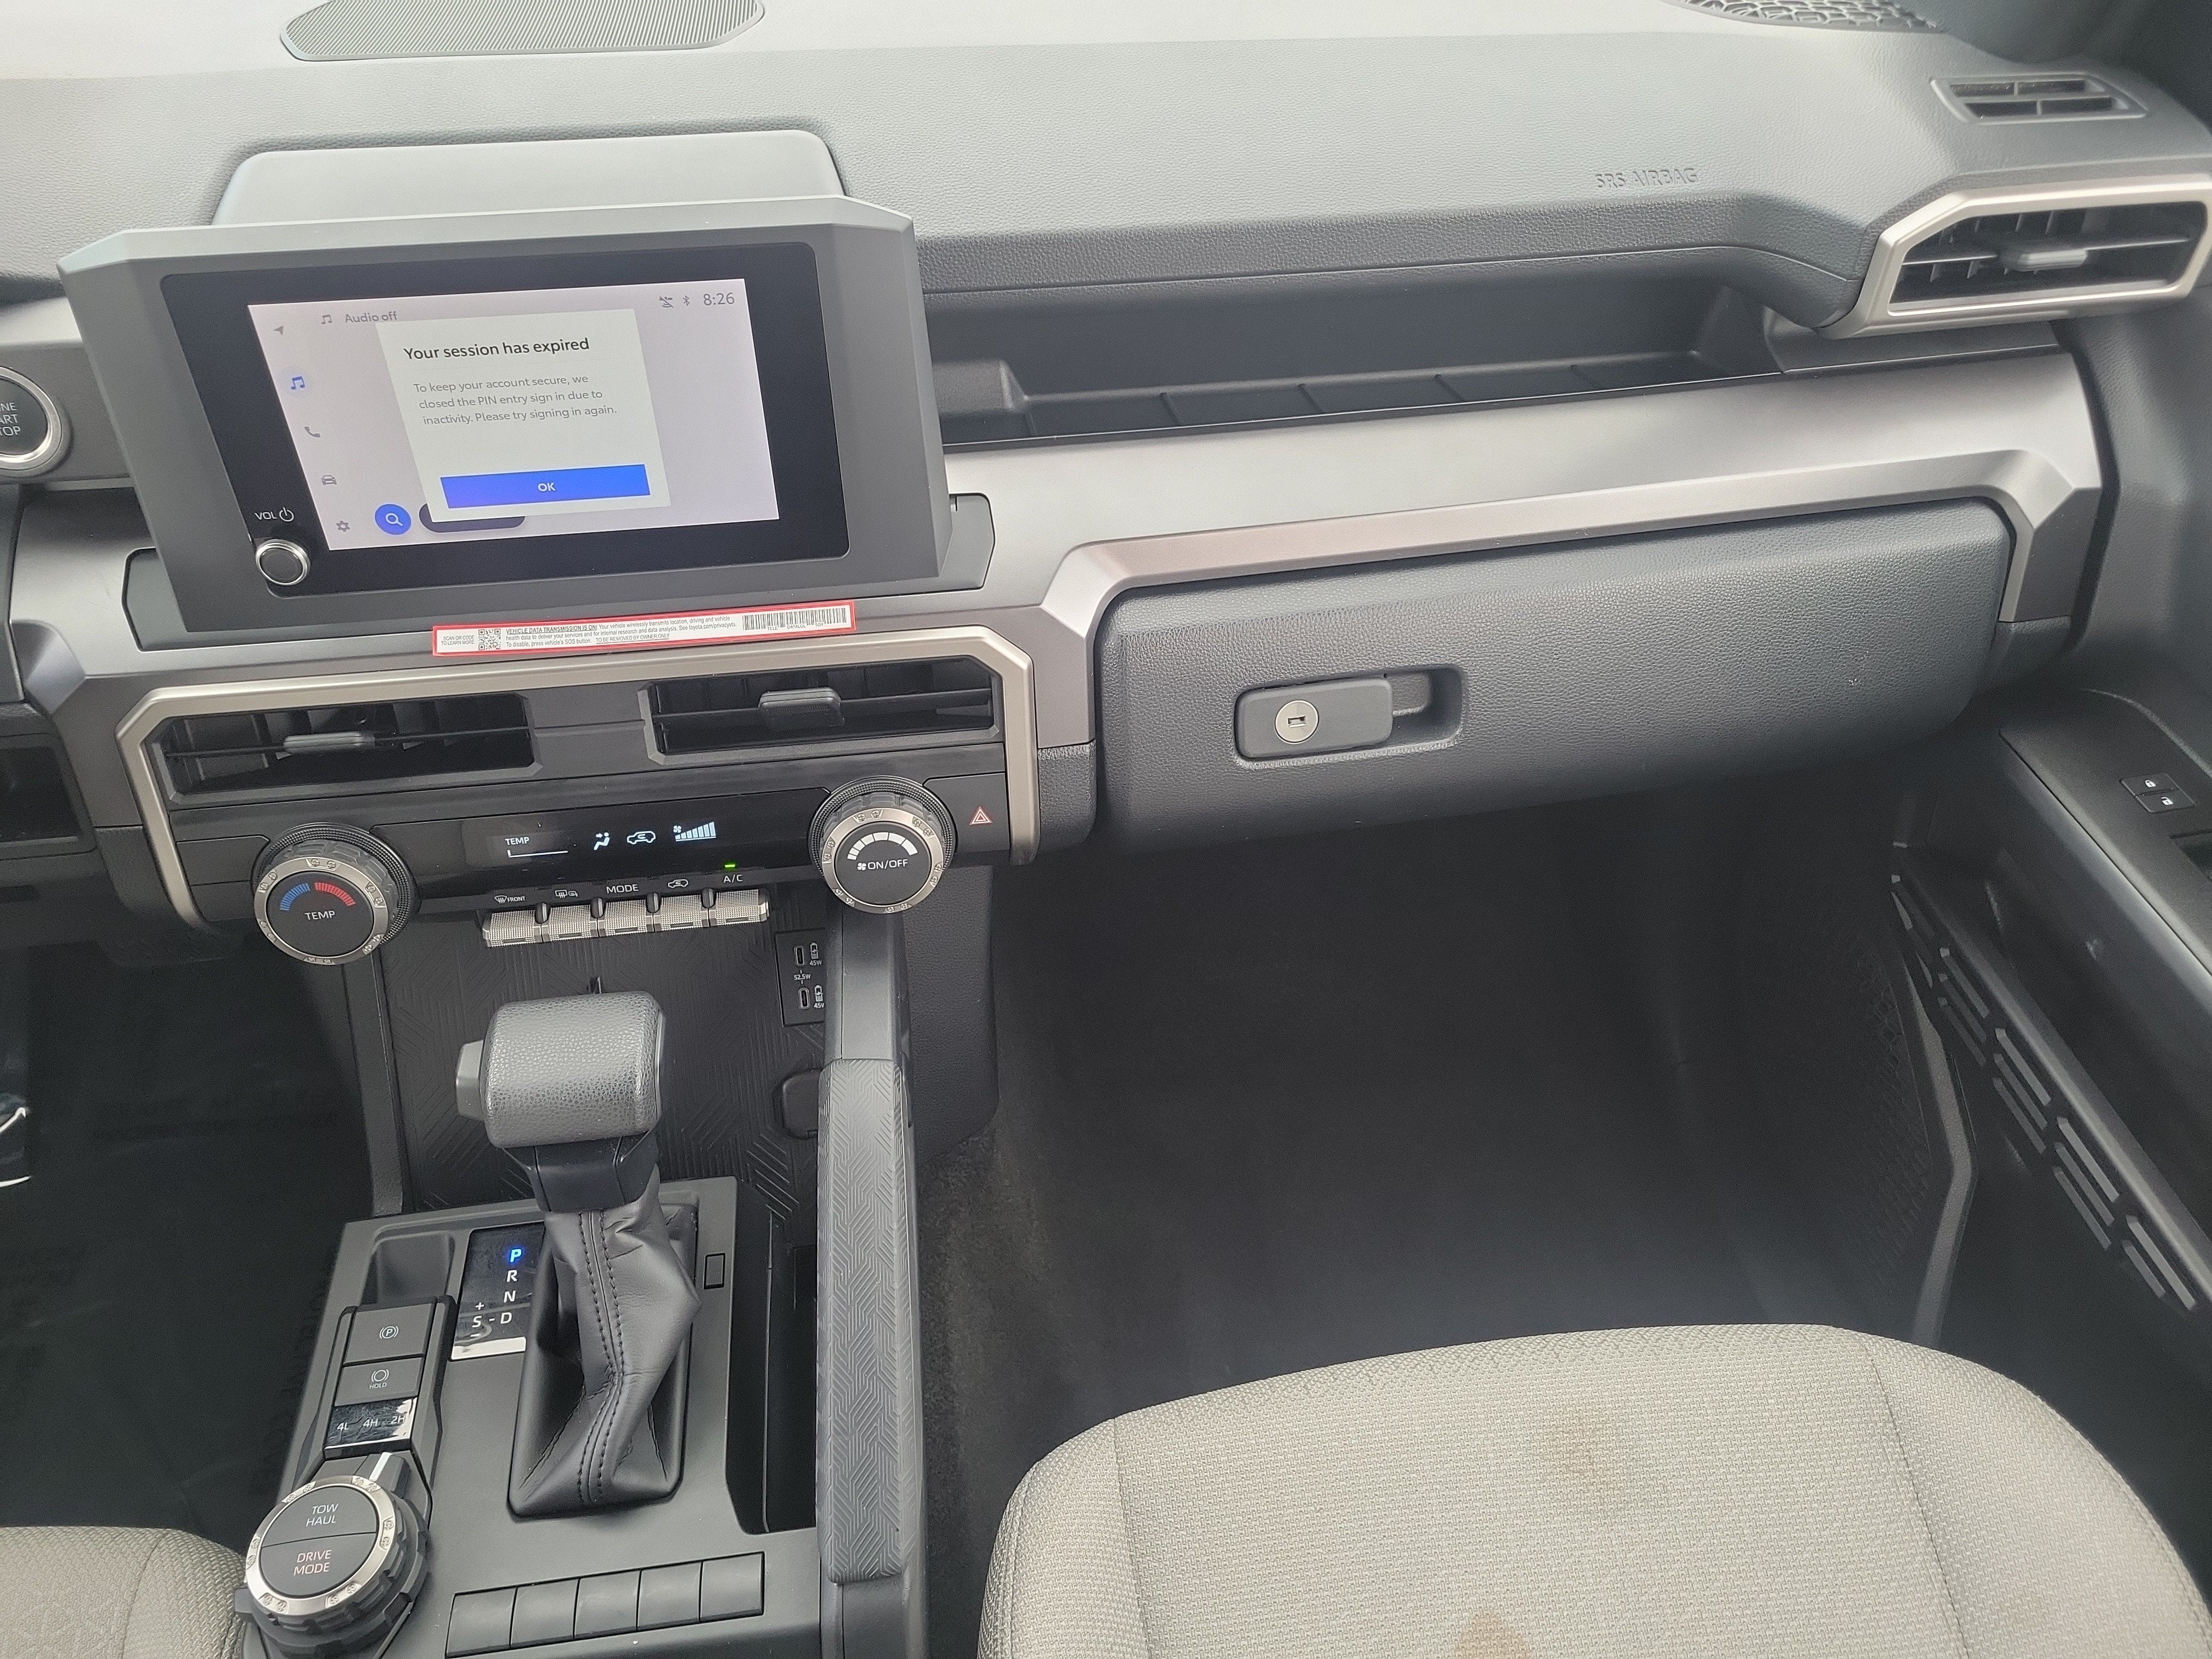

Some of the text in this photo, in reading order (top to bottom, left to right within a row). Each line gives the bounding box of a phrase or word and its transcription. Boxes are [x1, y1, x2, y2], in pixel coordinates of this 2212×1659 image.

[1595, 168, 1699, 188] SRS AIRBAG
[703, 292, 735, 306] 8:26
[345, 311, 398, 323] Audio off
[403, 337, 590, 360] Your session has expired
[414, 383, 427, 393] To
[430, 383, 456, 393] keep
[459, 382, 483, 392] your
[486, 378, 531, 389] account
[532, 377, 570, 385] secure,
[419, 398, 455, 409] closed
[457, 398, 476, 407] the
[478, 396, 497, 405] PIN
[499, 395, 527, 405] entry
[530, 393, 552, 404] sign
[555, 392, 565, 400] in
[568, 391, 589, 399] due
[0, 403, 17, 411] NE
[423, 405, 617, 425] inactivity. Please try signing in again.
[538, 482, 556, 492] OK
[254, 511, 278, 520] VOL
[505, 837, 529, 845] TEMP
[867, 859, 909, 870] ON/OFF
[723, 873, 743, 884] A/C
[606, 884, 639, 894] MODE
[304, 910, 335, 921] TEMP
[509, 1249, 522, 1262] P
[506, 1269, 518, 1282] R
[503, 1290, 516, 1303] N
[472, 1315, 482, 1328] S
[500, 1312, 512, 1324] D
[336, 1415, 406, 1431] 4L 4H 2H
[312, 1503, 339, 1515] TOW
[306, 1515, 337, 1527] HAUL
[296, 1549, 332, 1563] DRIVE
[293, 1562, 331, 1576] MODE
